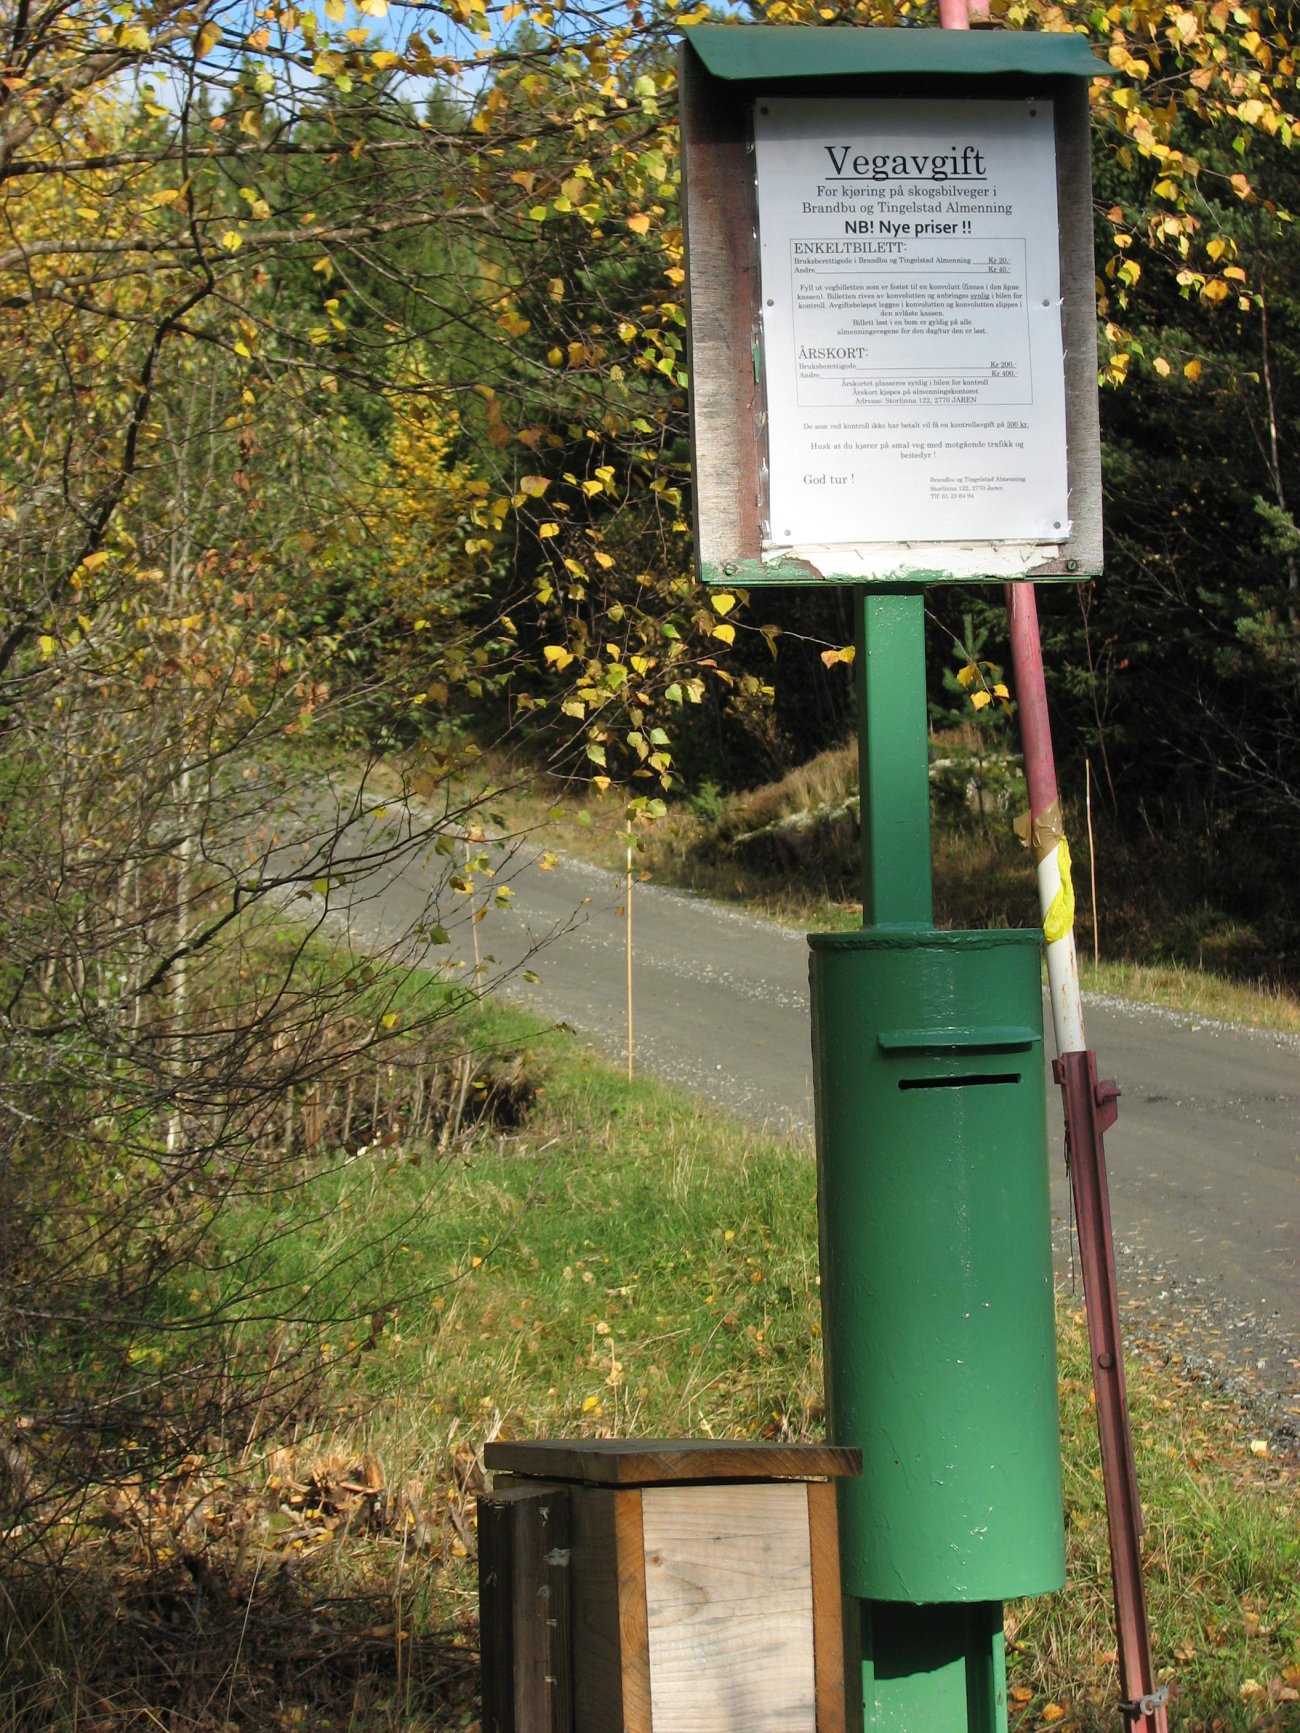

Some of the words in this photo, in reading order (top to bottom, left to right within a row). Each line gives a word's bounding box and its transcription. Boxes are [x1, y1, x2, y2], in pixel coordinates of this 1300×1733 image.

[824, 146, 986, 181] Vegavgift
[817, 186, 838, 196] For
[841, 186, 885, 198] kjøring
[890, 185, 903, 198] på
[908, 185, 989, 198] skogsbilveger
[803, 203, 856, 214] Brandbu
[860, 205, 874, 215] og
[878, 202, 942, 215] Tingelstad
[946, 202, 1012, 215] Almenning
[845, 221, 873, 233] NB!
[880, 221, 910, 237] Nye
[915, 220, 958, 237] priser
[962, 221, 971, 233] !!
[794, 242, 907, 253] ENKELTBILETT:
[1004, 283, 1019, 291] åpne
[799, 345, 868, 359] ÅRSKORT:
[842, 379, 872, 387] Årskortet
[856, 442, 878, 450] kjører
[881, 442, 889, 450] på
[945, 441, 985, 449] motgående
[803, 474, 826, 484] God
[830, 476, 847, 484] tur
